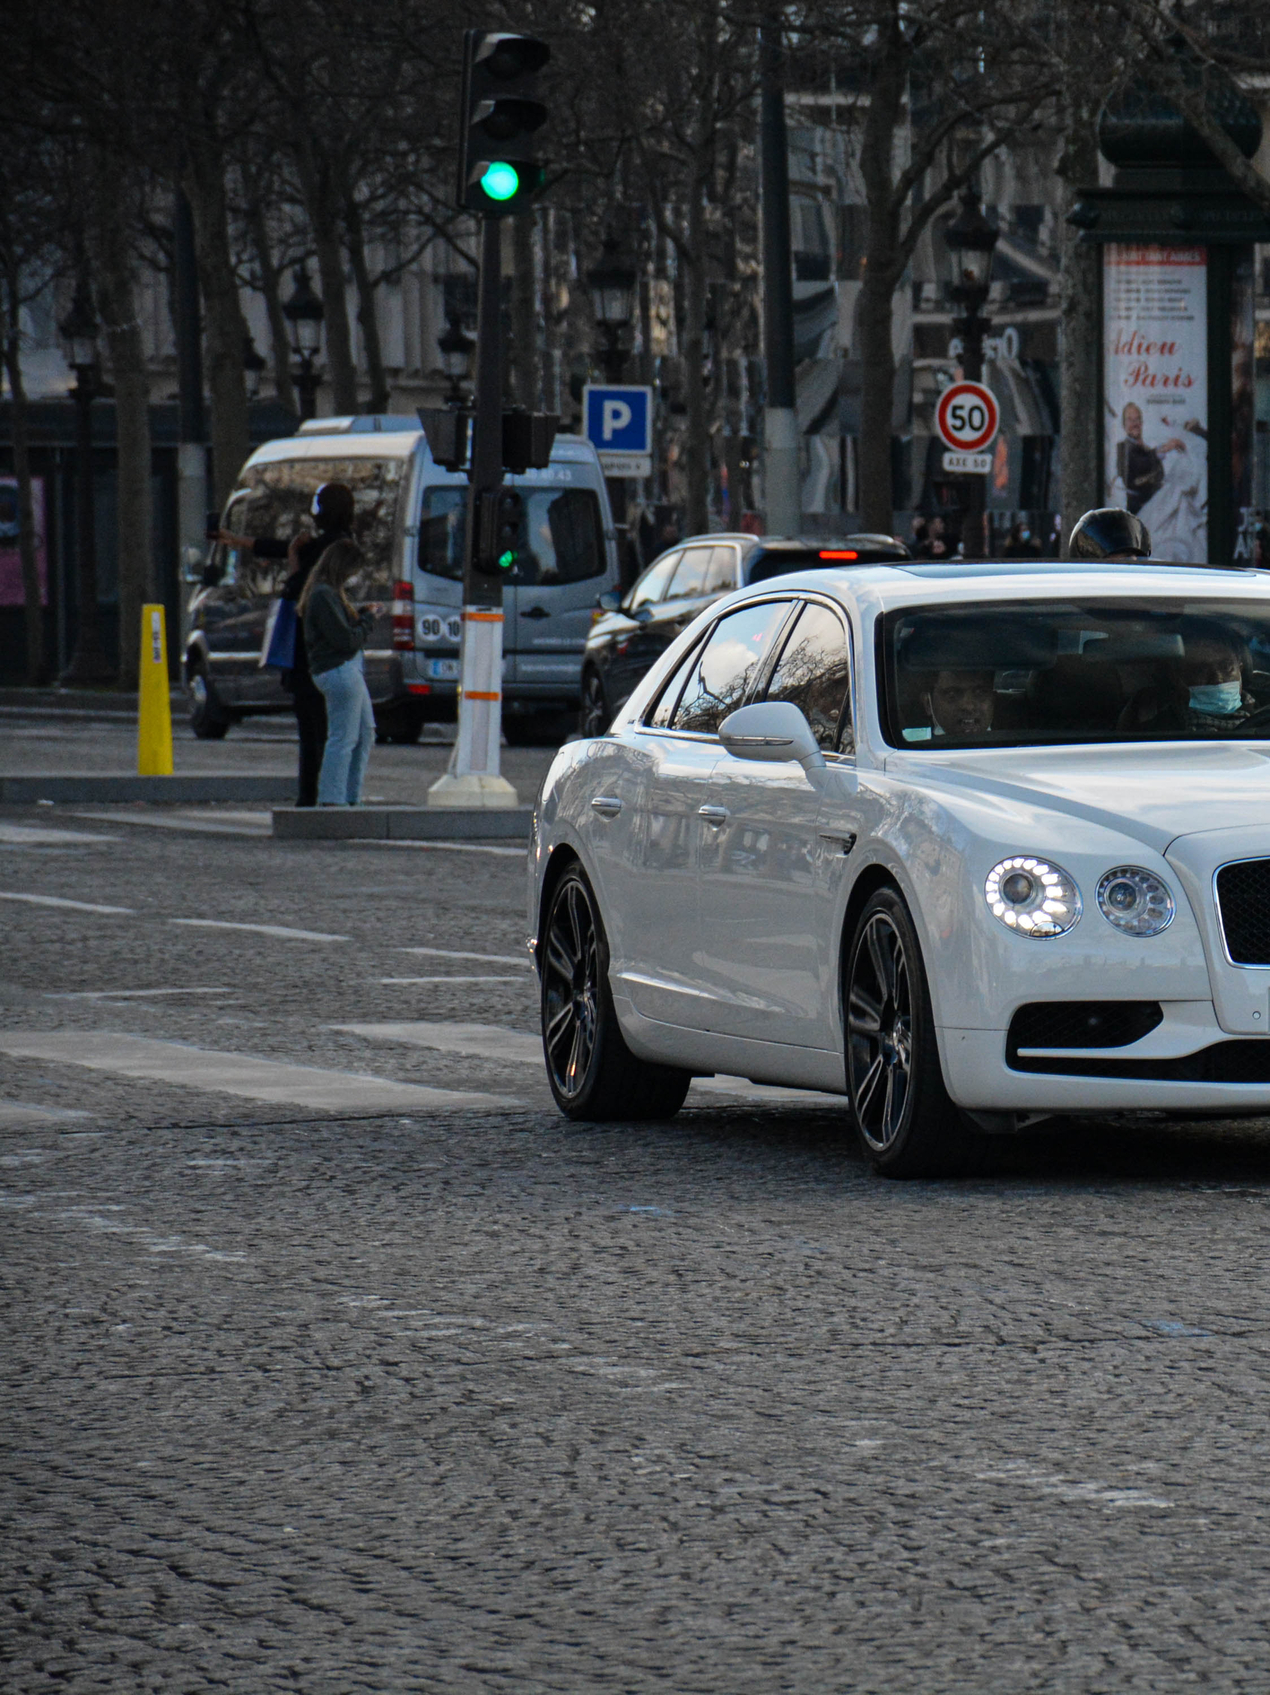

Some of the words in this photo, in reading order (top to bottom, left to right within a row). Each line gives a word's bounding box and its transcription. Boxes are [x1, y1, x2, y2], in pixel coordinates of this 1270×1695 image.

[1122, 361, 1197, 388] Paris
[603, 399, 632, 441] P
[951, 405, 985, 431] 50
[948, 456, 968, 468] AXE
[973, 458, 988, 469] 50
[422, 618, 440, 636] 90
[447, 619, 461, 637] 10
